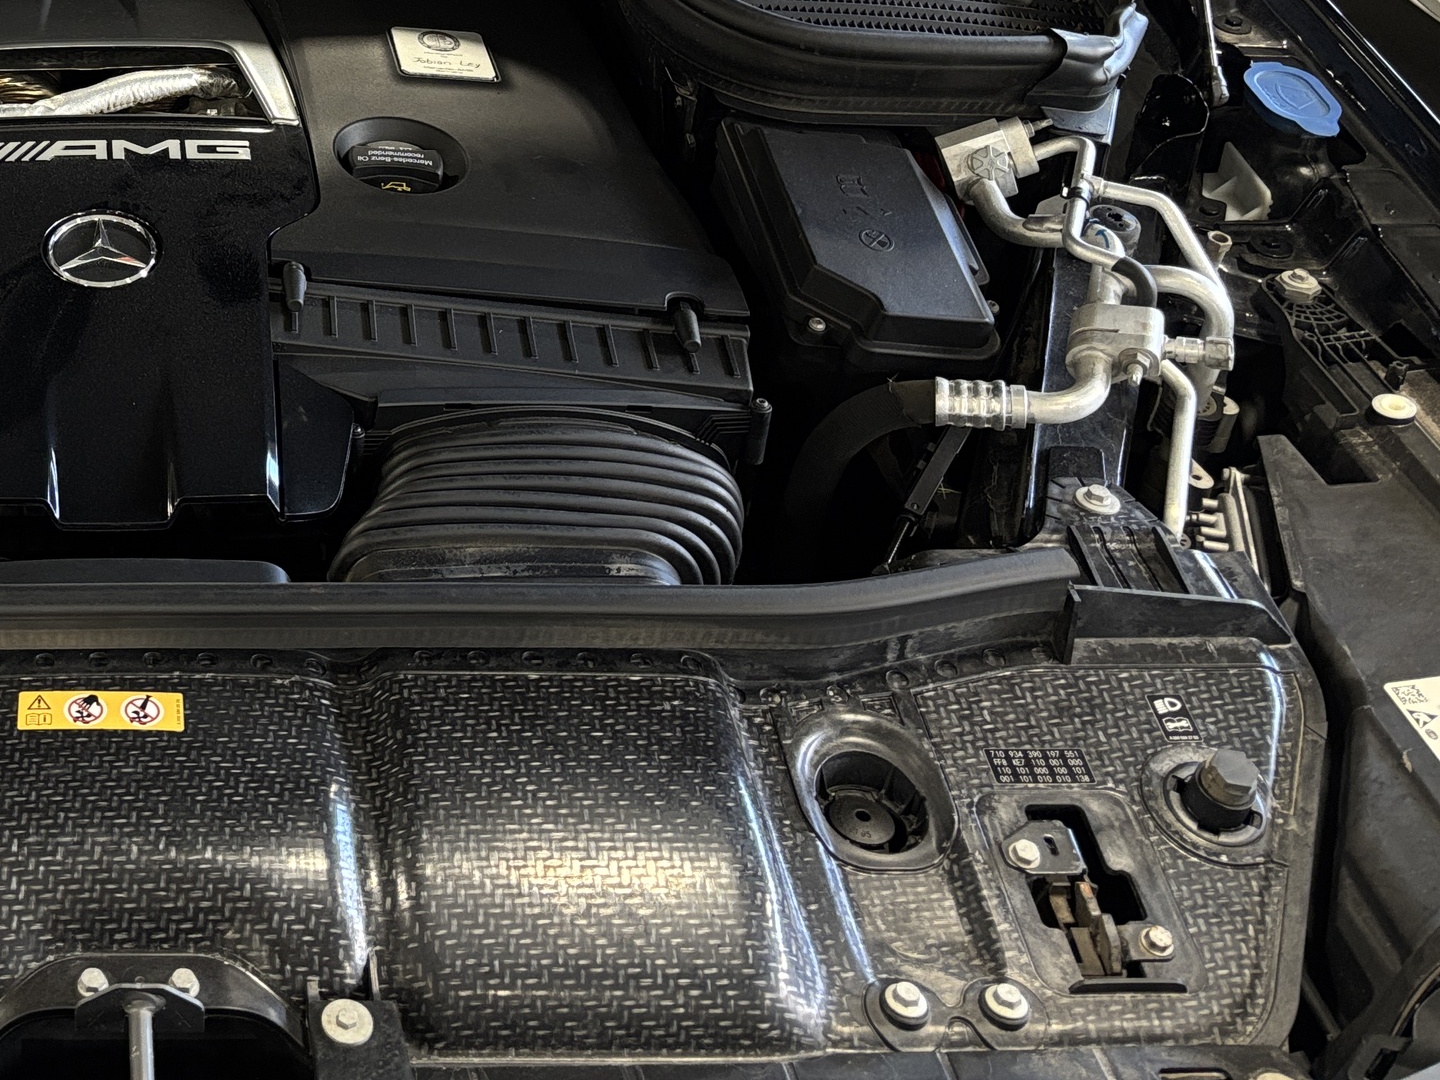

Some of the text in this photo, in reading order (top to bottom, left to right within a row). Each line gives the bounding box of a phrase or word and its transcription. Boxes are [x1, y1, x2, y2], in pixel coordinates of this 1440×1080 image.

[36, 139, 252, 162] AMG
[368, 150, 424, 159] recommended
[371, 155, 433, 166] Mercedes-Benz
[989, 750, 1005, 758] 710
[1026, 750, 1042, 758] 390
[1046, 750, 1059, 758] 197
[1064, 750, 1079, 758] 551
[1031, 758, 1046, 766] 110
[1049, 758, 1064, 766] 001
[1067, 758, 1083, 766] 000
[997, 766, 1086, 774] 110 101 000 100 101
[999, 775, 1090, 783] 001 101 010 010 138
